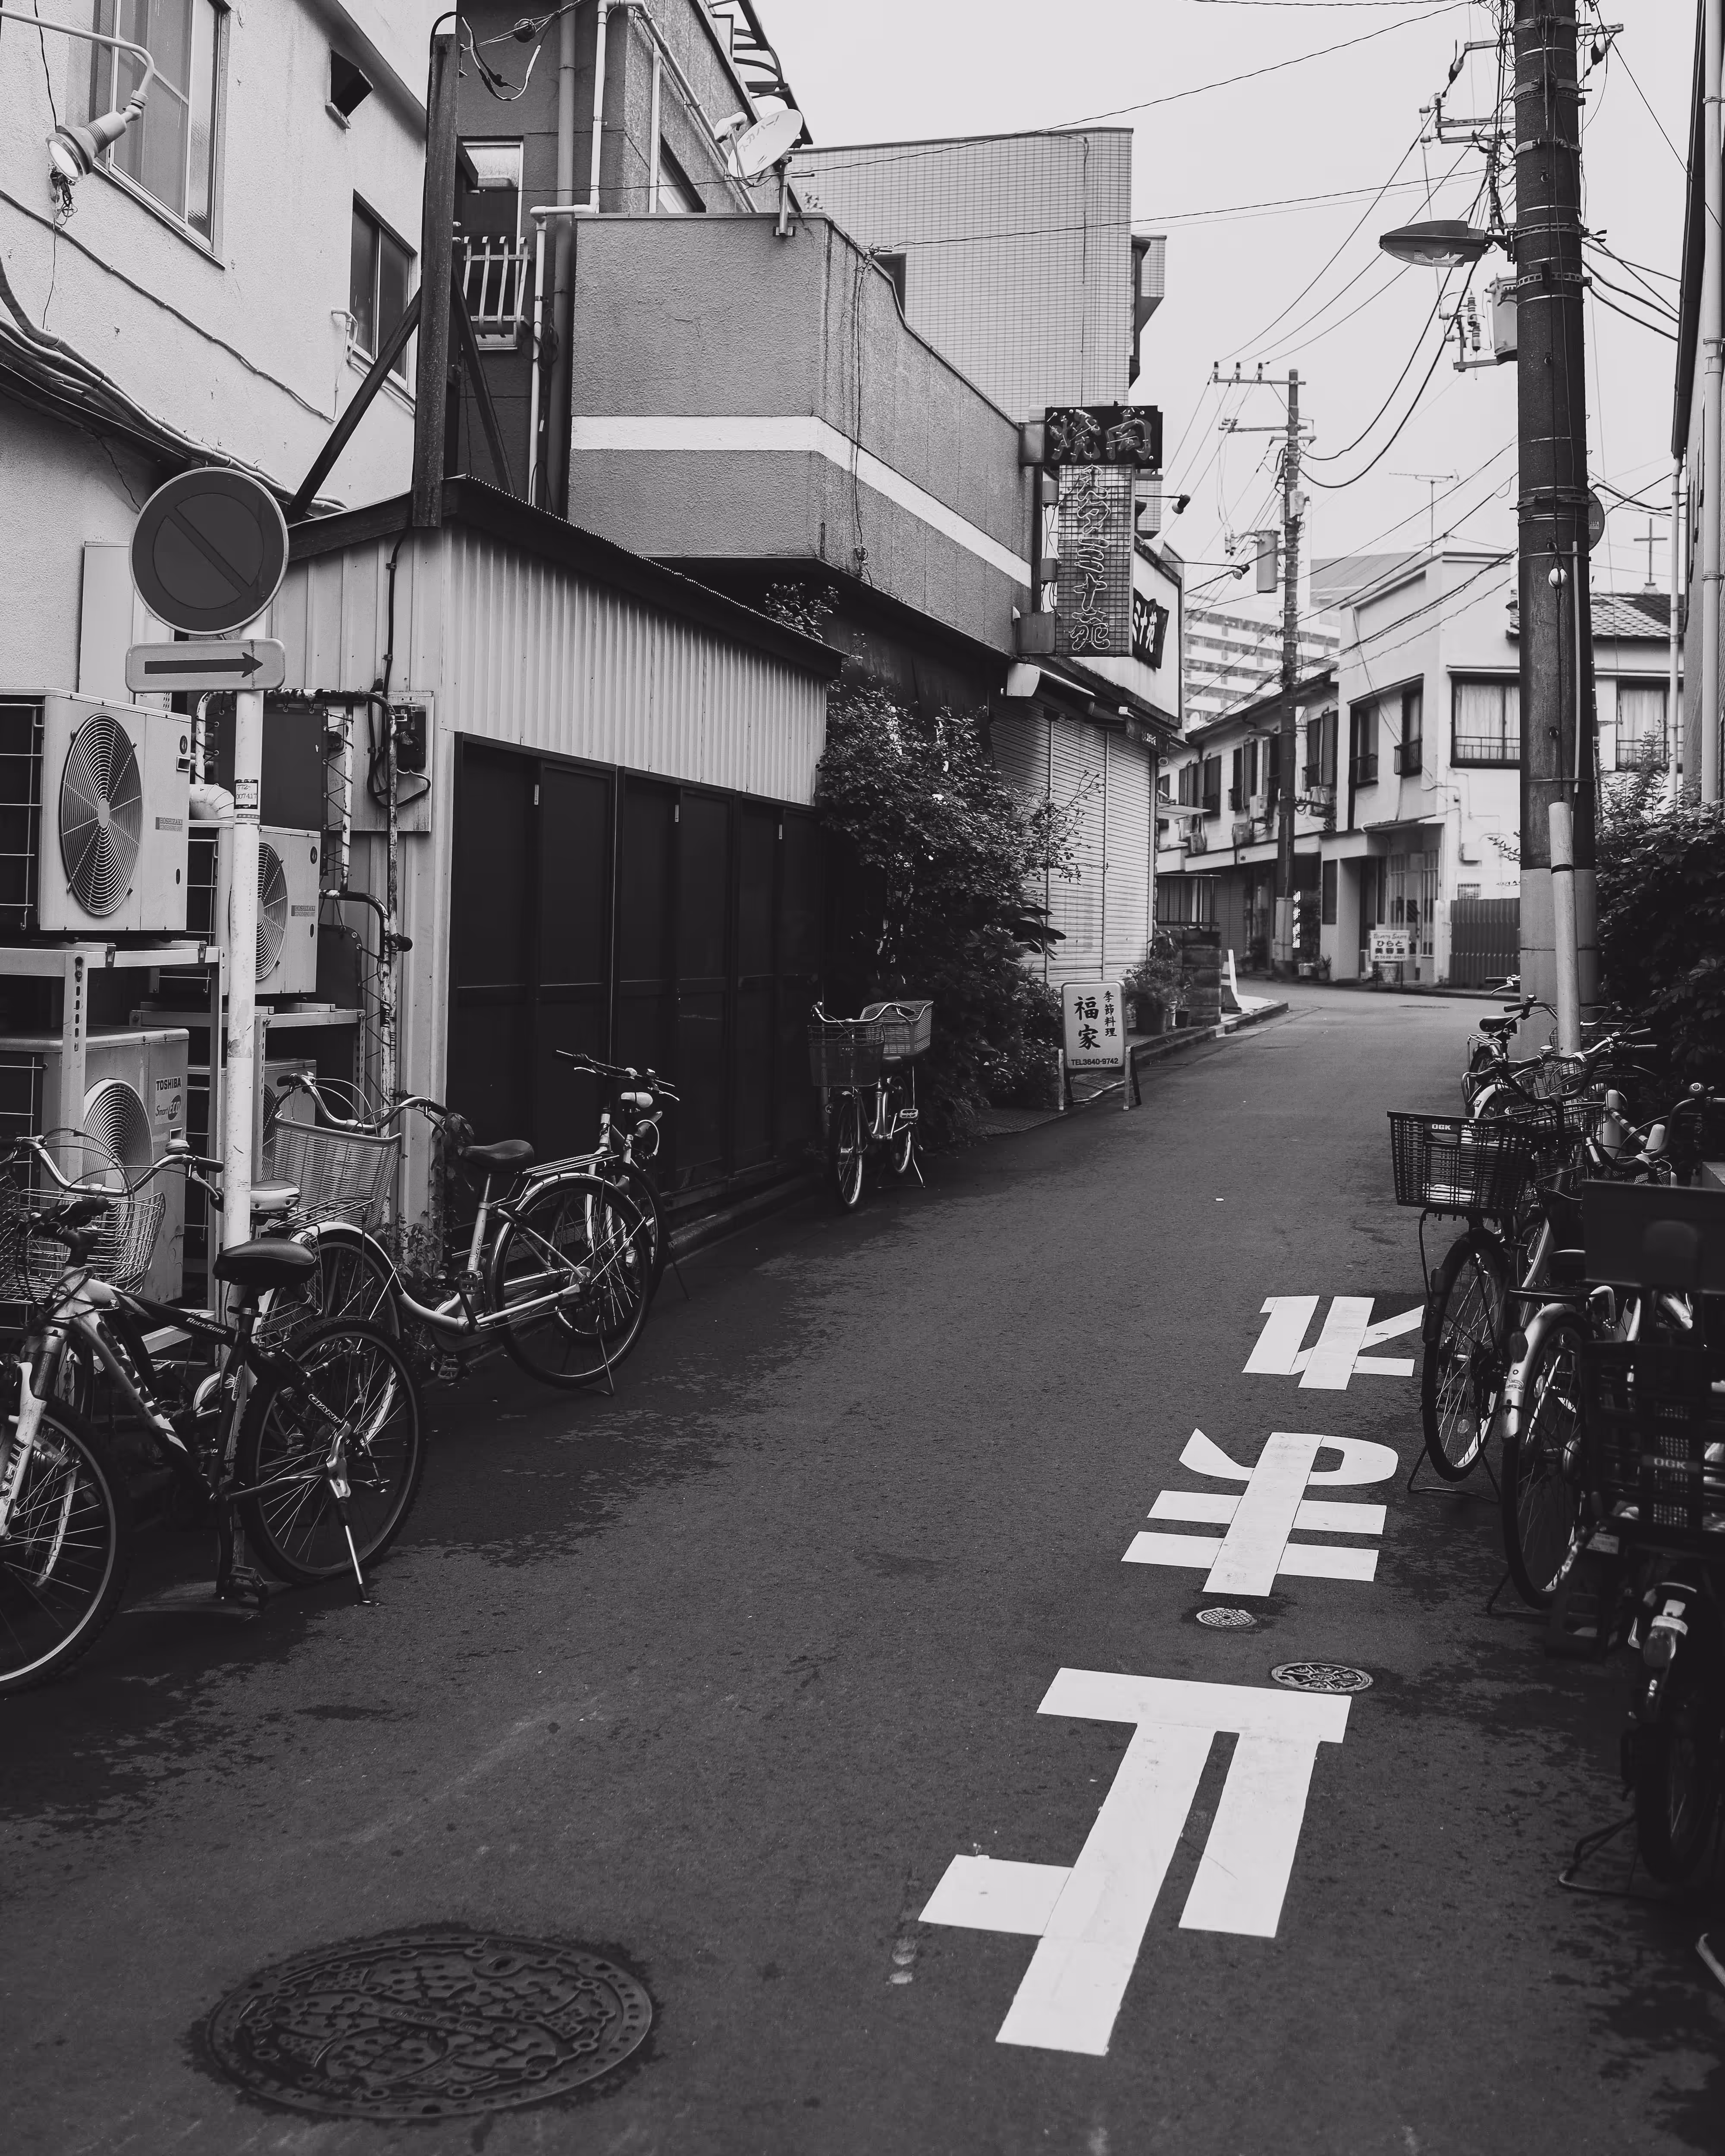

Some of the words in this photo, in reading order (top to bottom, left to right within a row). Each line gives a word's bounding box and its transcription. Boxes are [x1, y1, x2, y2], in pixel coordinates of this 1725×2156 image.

[160, 817, 183, 825] HOSHIZAKI
[1074, 996, 1101, 1050] 福家
[1103, 990, 1117, 1037] 季節料理
[156, 1078, 181, 1091] TOSHIBA
[308, 1394, 342, 1423] GIANT
[1653, 1457, 1688, 1470] OGK
